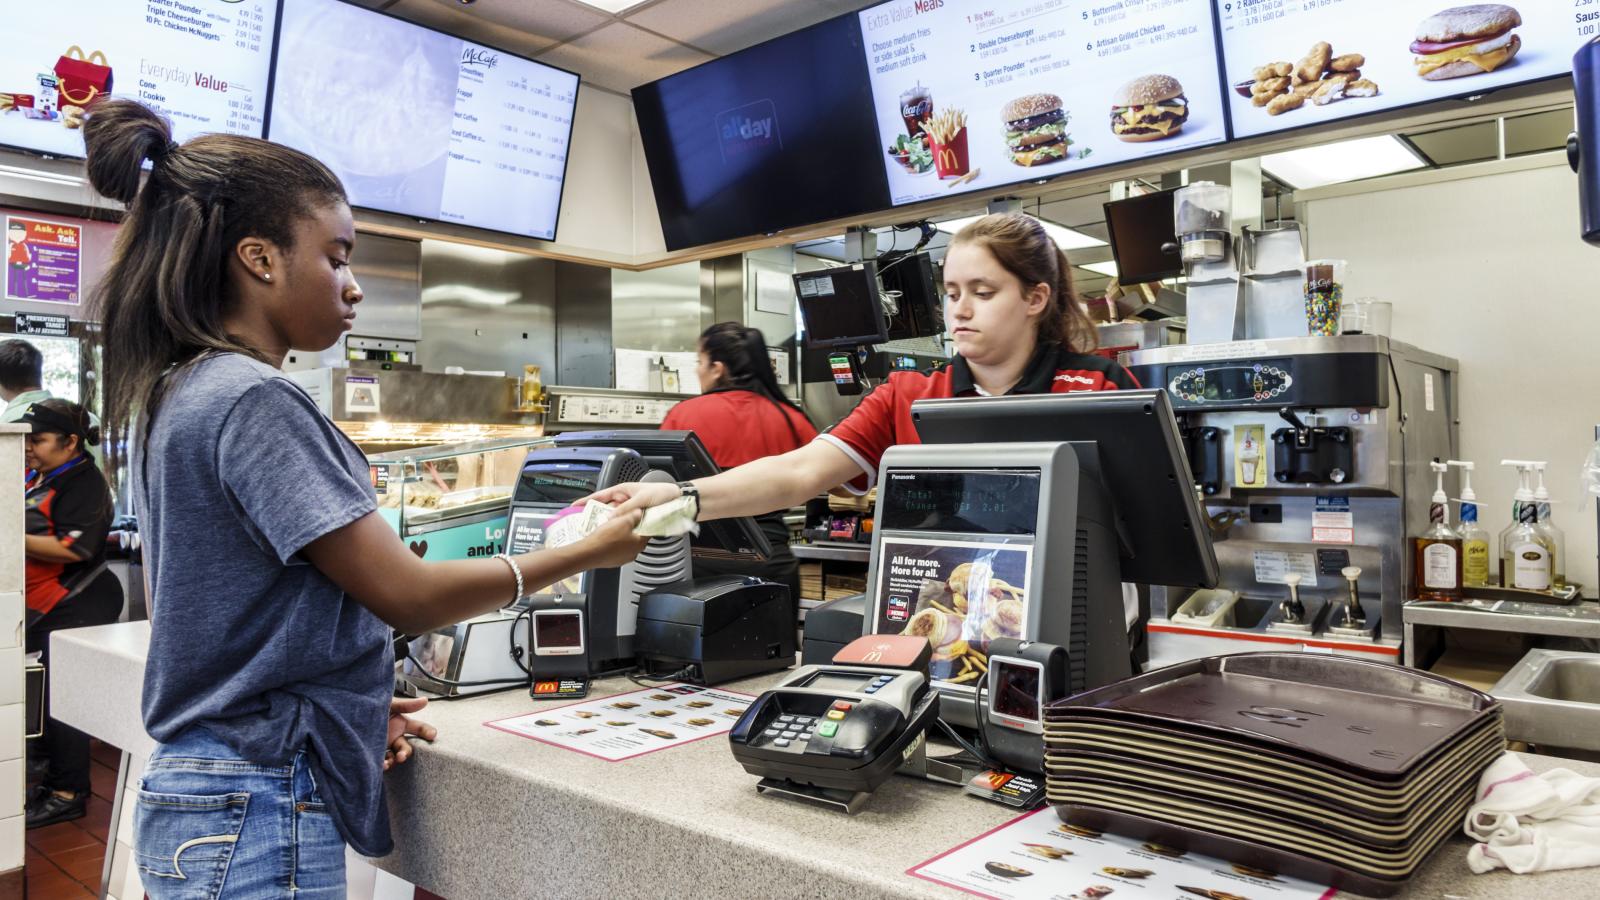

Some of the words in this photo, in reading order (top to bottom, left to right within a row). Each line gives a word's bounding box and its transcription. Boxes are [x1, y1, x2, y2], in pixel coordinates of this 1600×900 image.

[174, 2, 202, 15] Pounder
[867, 14, 890, 31] Extra
[890, 6, 912, 22] Value
[915, 0, 944, 14] Meals
[1092, 2, 1124, 17] Buttermilk
[1225, 4, 1231, 12] 9
[147, 4, 166, 16] Triple
[167, 11, 213, 28] Cheeseburger
[164, 20, 188, 32] Chicken
[188, 27, 220, 41] McNuggets
[1096, 36, 1118, 48] Artisan
[1119, 29, 1139, 41] Grilled
[1140, 24, 1165, 36] Chicken
[1578, 25, 1594, 36] 1.00
[872, 39, 892, 52] Choose
[894, 31, 916, 45] medium
[979, 39, 996, 50] Double
[997, 29, 1034, 44] Cheeseburger
[881, 50, 893, 60] side
[894, 45, 909, 57] salad
[876, 62, 898, 74] medium
[900, 57, 911, 67] soft
[912, 52, 927, 63] drink
[140, 58, 191, 86] Everyday
[195, 72, 228, 92] Value
[975, 72, 980, 81] 3
[983, 68, 1002, 79] Quarter
[1003, 62, 1025, 72] Pounder
[139, 79, 156, 90] Cone
[143, 90, 166, 102] Cookie
[34, 224, 55, 233] Ask.
[57, 228, 77, 236] Ask.
[58, 234, 77, 244] Tell.
[467, 542, 494, 556] and
[892, 556, 903, 564] All
[905, 556, 916, 566] for
[891, 566, 911, 575] More
[912, 567, 924, 576] for
[925, 568, 939, 578] all.
